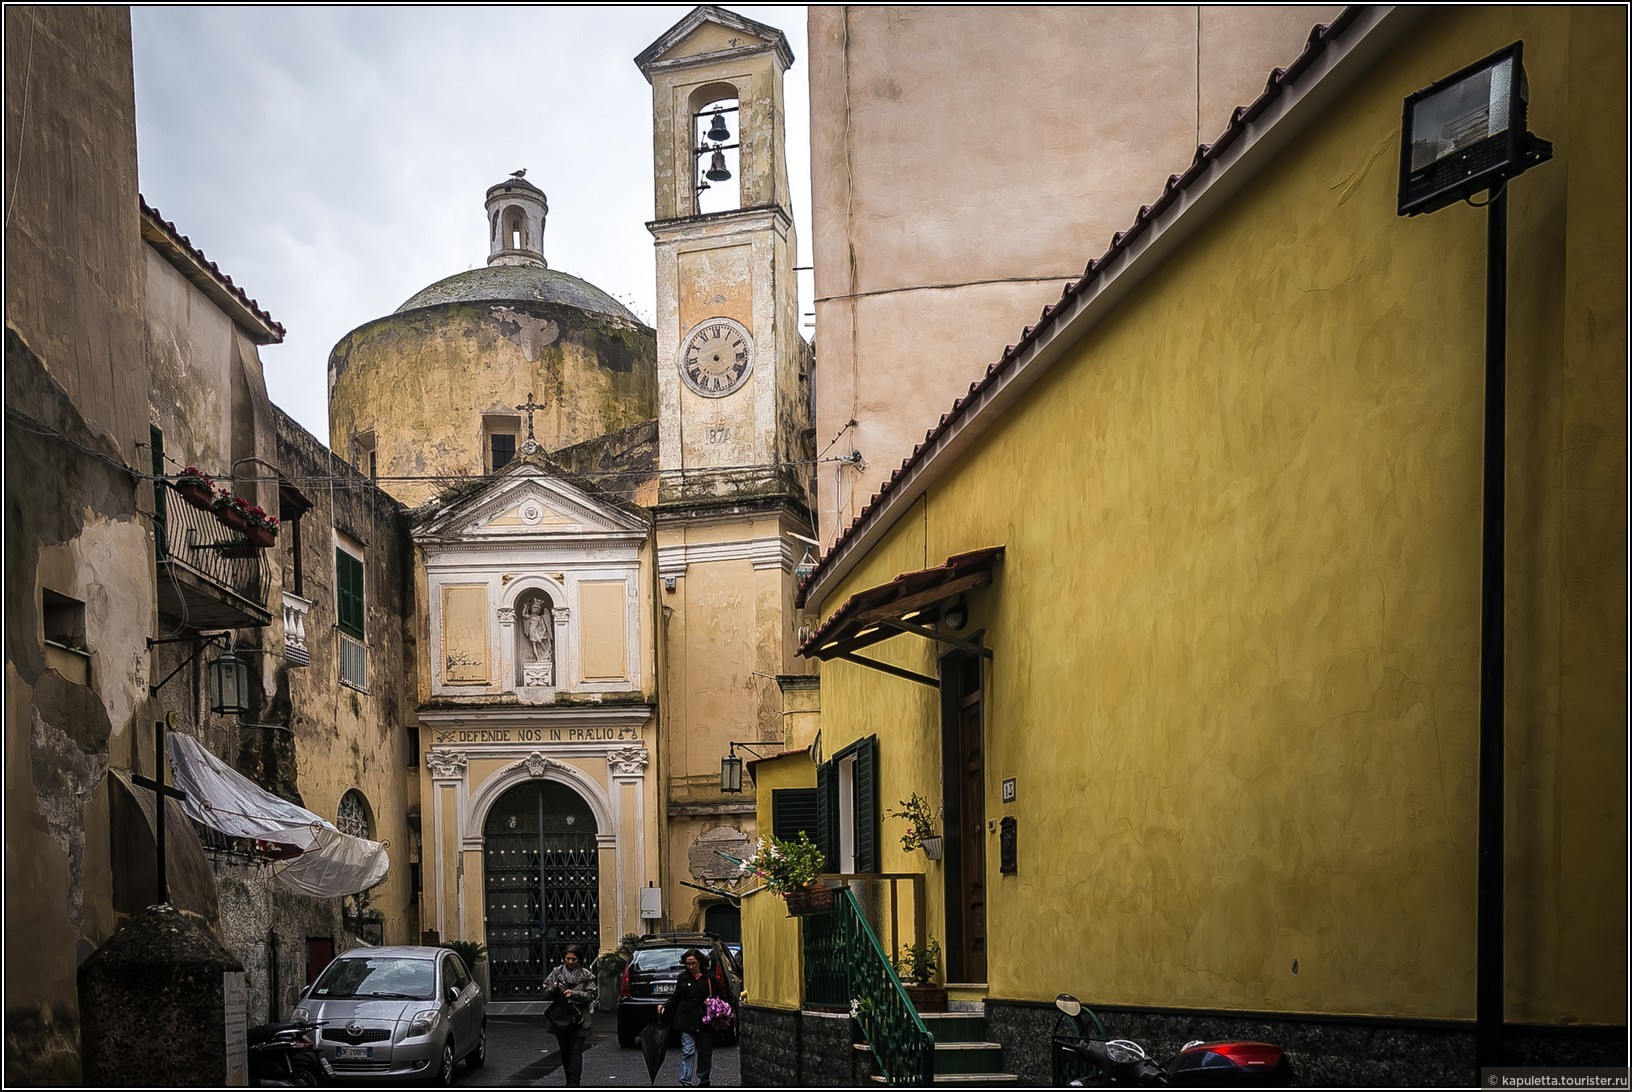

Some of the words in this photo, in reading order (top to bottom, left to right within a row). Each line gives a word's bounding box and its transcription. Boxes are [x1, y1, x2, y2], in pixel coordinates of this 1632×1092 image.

[460, 730, 511, 741] DEFENDE
[518, 729, 542, 742] NOS
[550, 729, 561, 741] IN
[569, 728, 614, 741] PRÆLIO
[1005, 784, 1013, 797] 13
